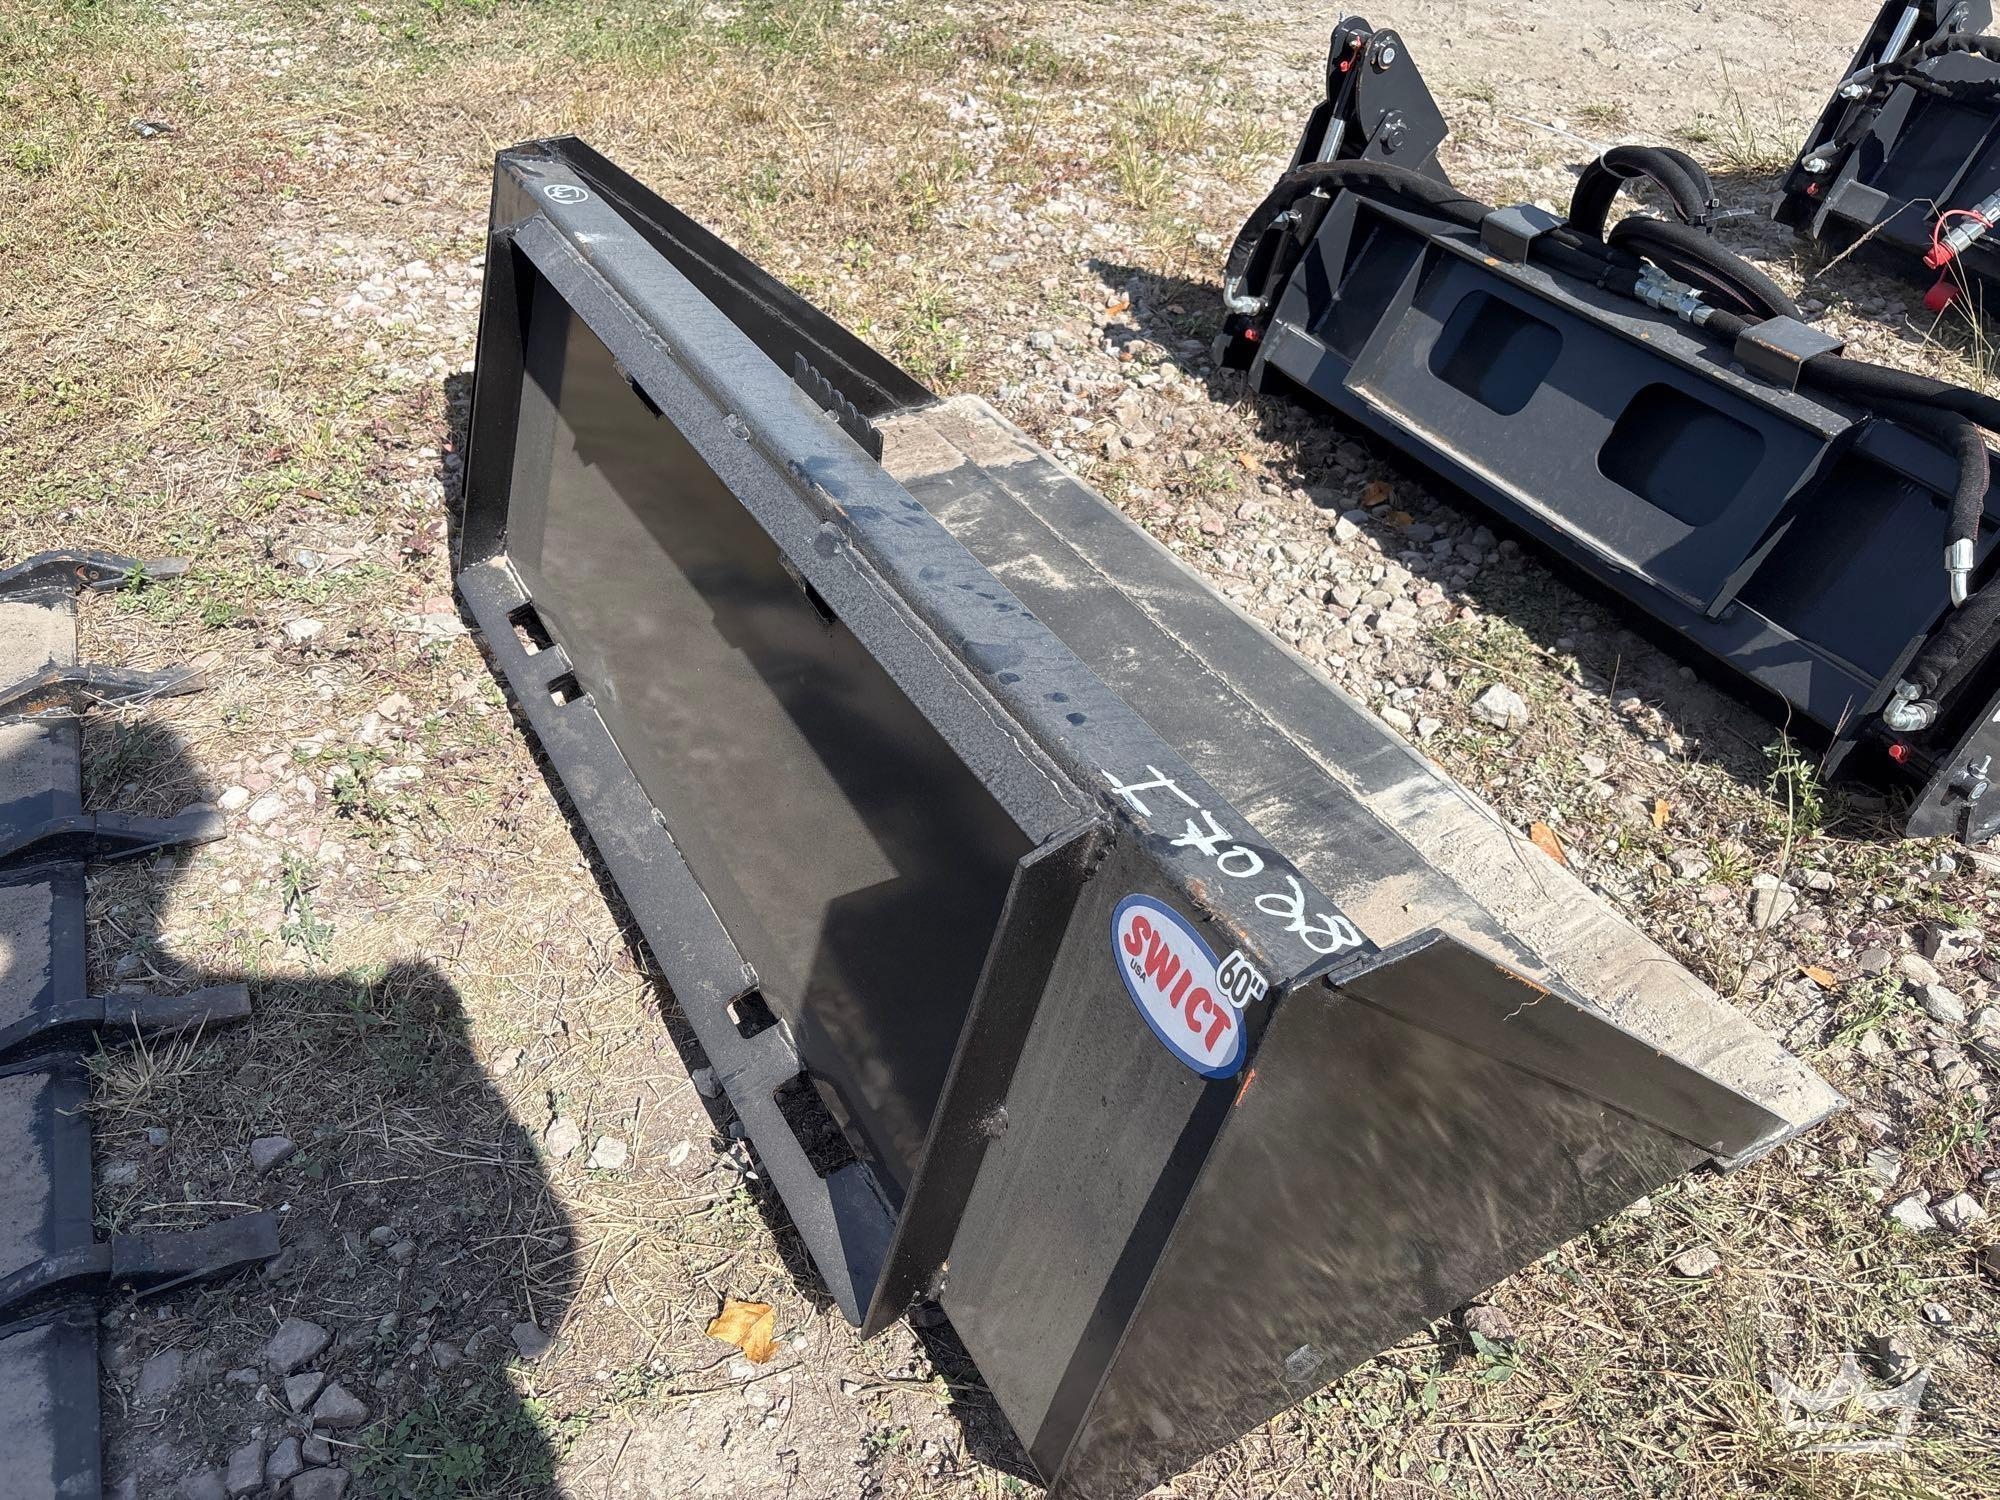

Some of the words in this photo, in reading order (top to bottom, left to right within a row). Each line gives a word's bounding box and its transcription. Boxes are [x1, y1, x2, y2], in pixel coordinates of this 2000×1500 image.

[1123, 915, 1232, 1053] SWICT
[1130, 958, 1147, 984] USA
[1219, 955, 1263, 1003] 60"
